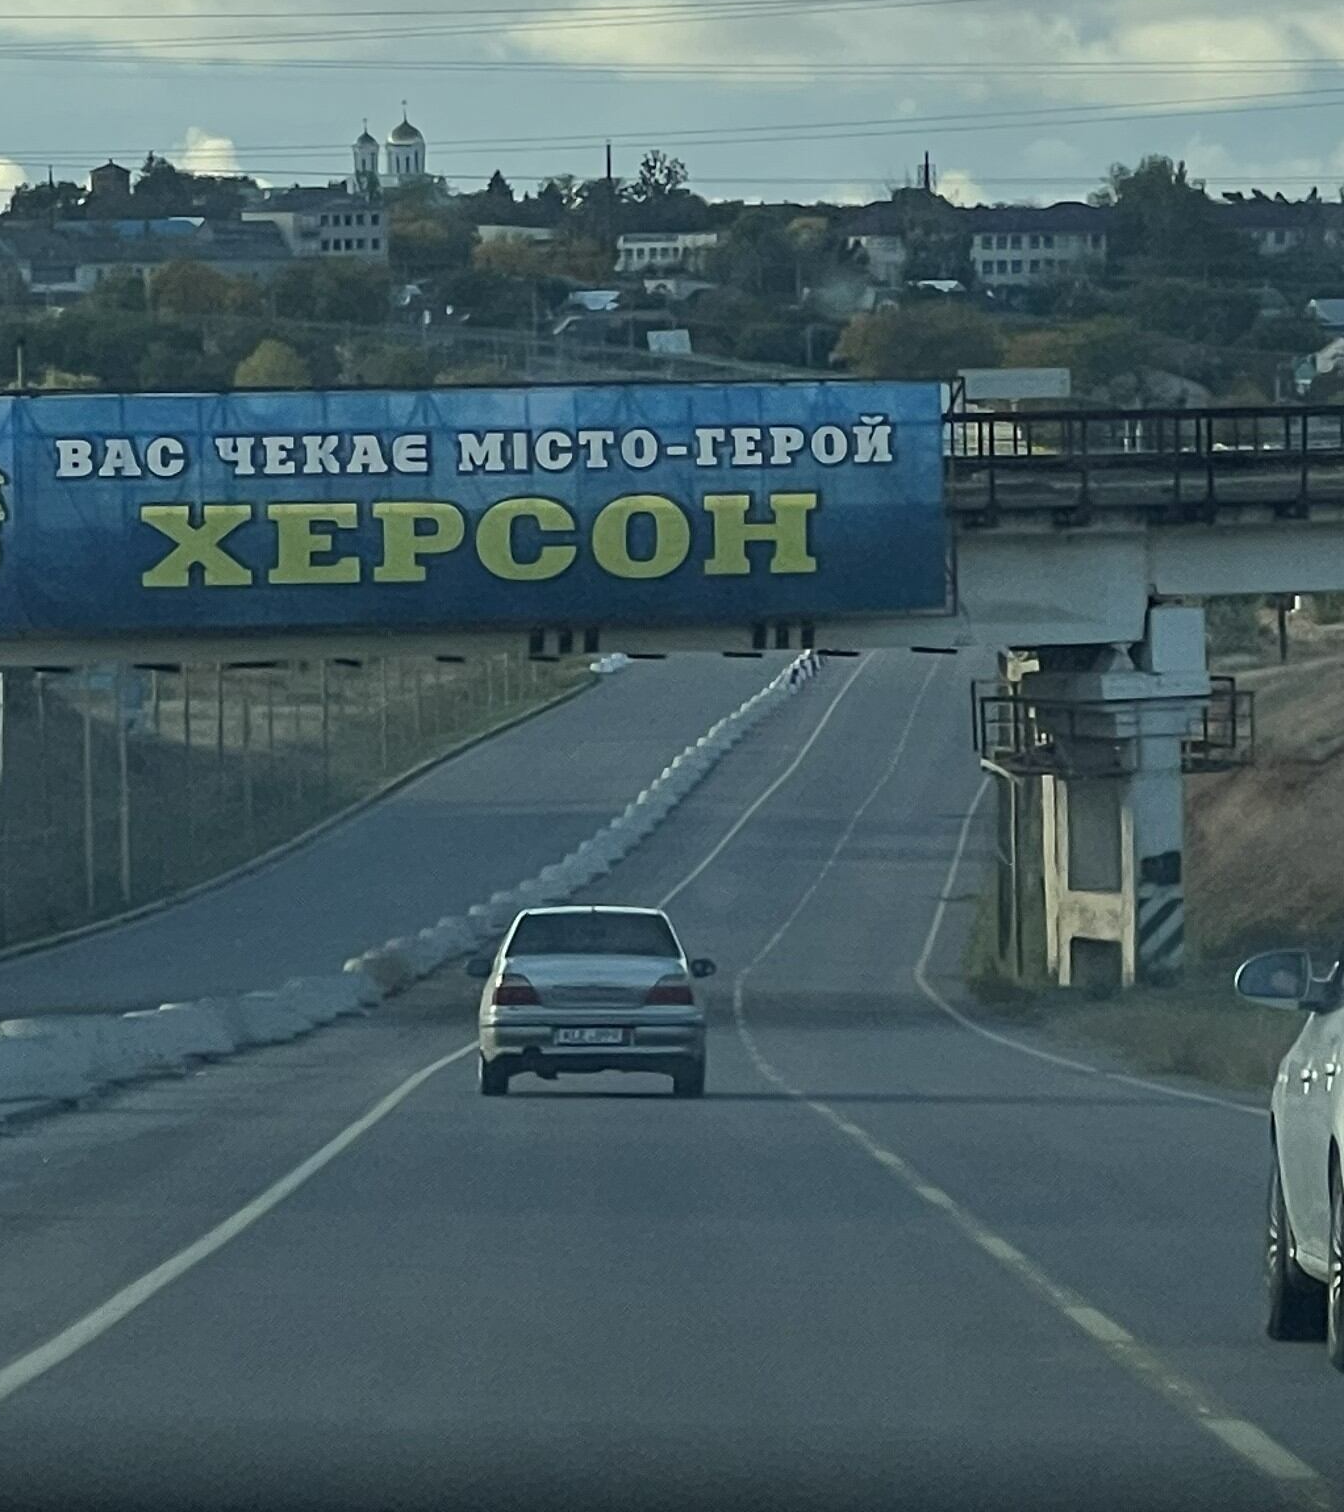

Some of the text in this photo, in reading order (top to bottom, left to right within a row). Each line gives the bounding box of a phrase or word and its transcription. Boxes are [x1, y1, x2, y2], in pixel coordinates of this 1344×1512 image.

[56, 415, 893, 477] ВАС ЧЕКАЄ МІСТО-ГЕРОЙ
[140, 493, 818, 587] ХЕРСОН
